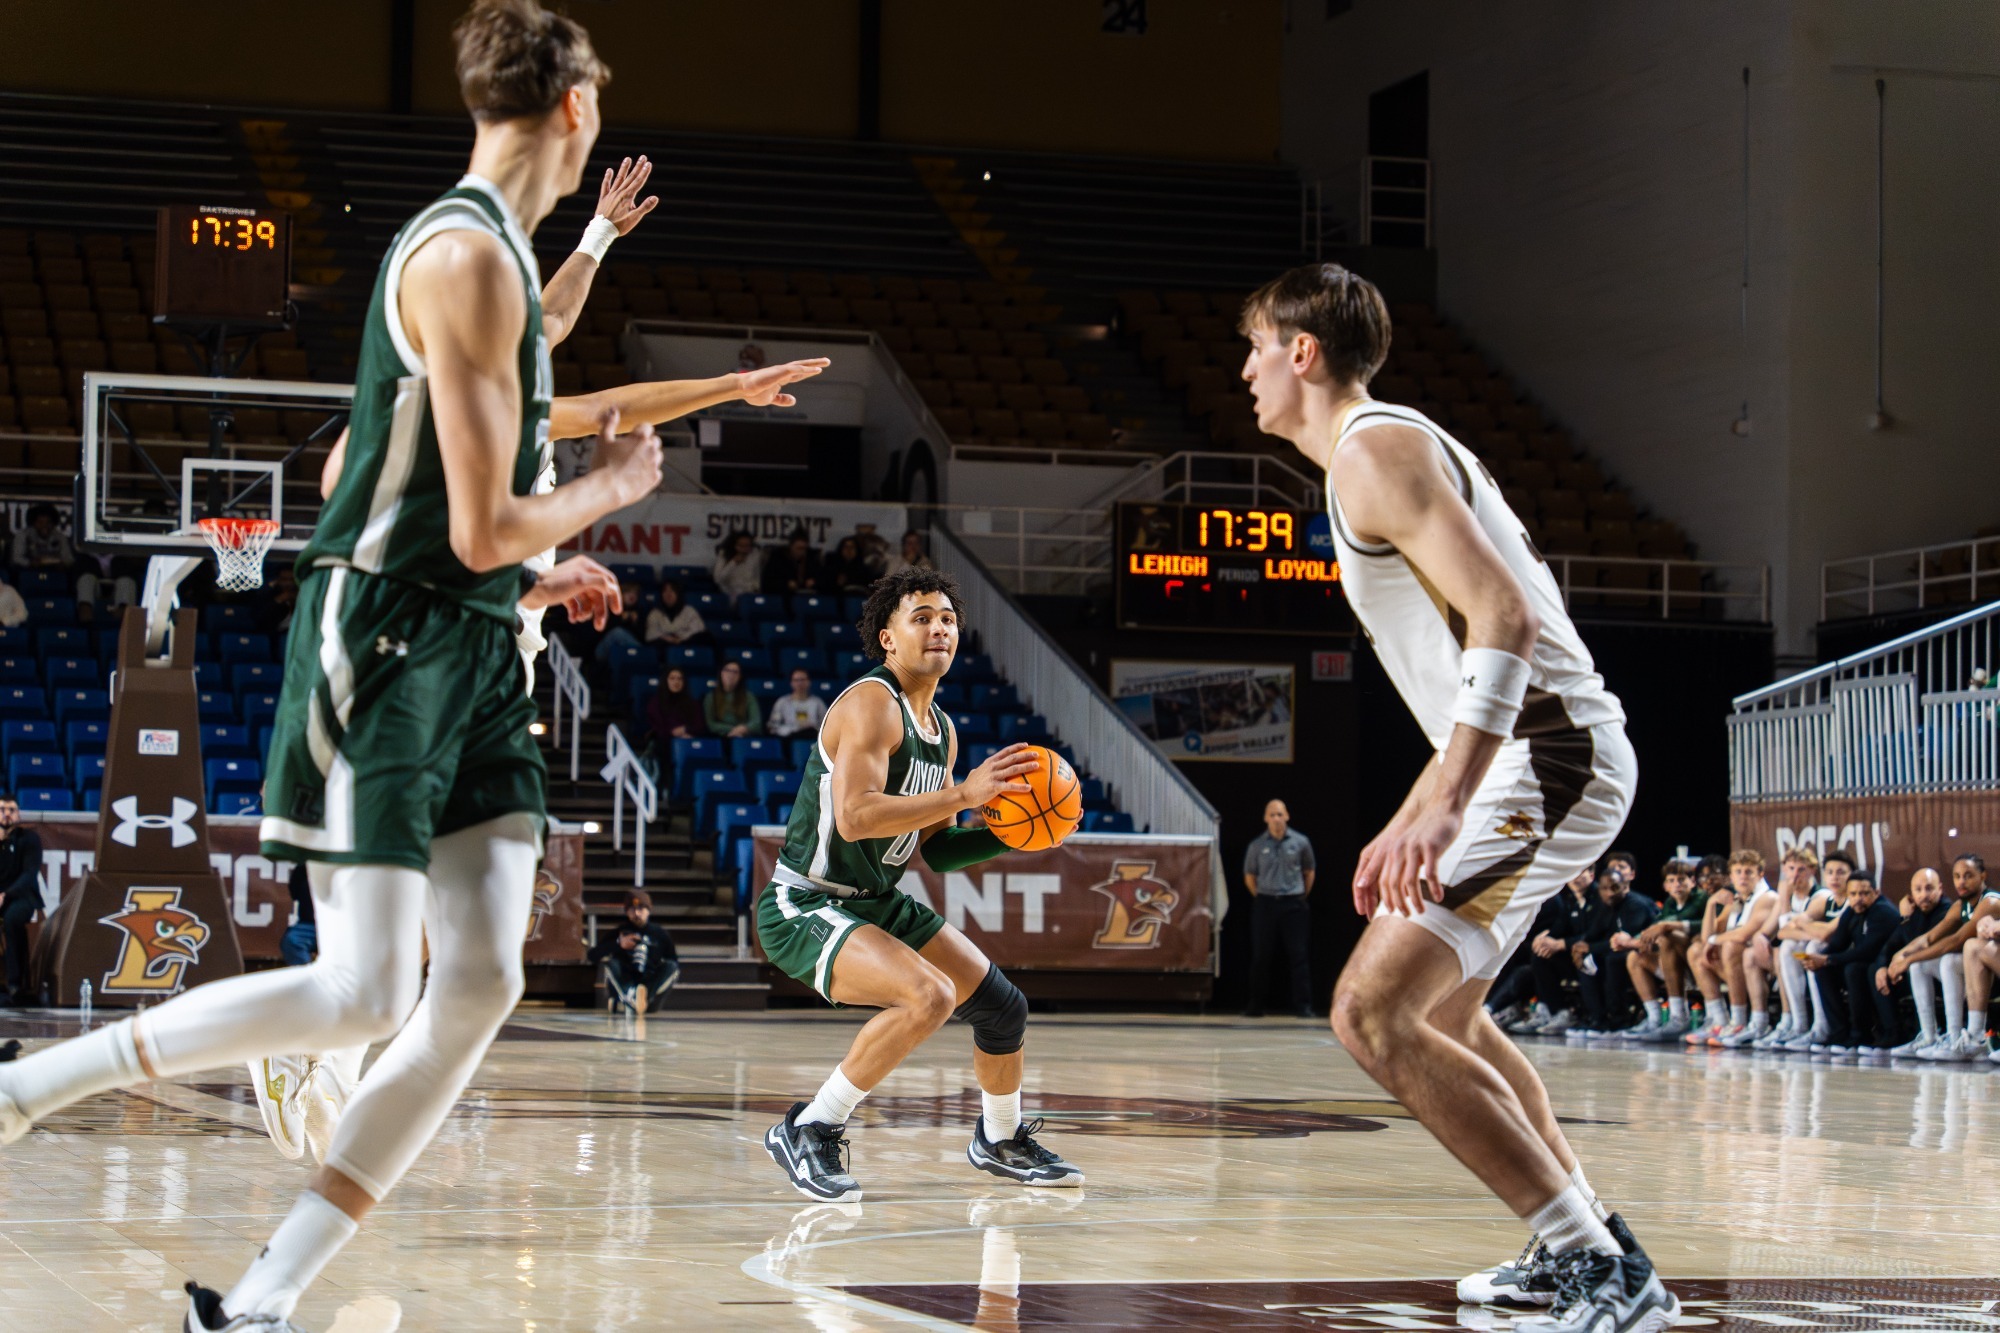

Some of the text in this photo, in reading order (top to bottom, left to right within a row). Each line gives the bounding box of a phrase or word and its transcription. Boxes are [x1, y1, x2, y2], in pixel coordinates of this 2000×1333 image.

[192, 217, 275, 250] 17:39
[557, 522, 691, 555] IANT
[1200, 510, 1293, 552] 17:39
[1129, 553, 1208, 577] LEHIGH
[899, 757, 947, 796] LOYOL
